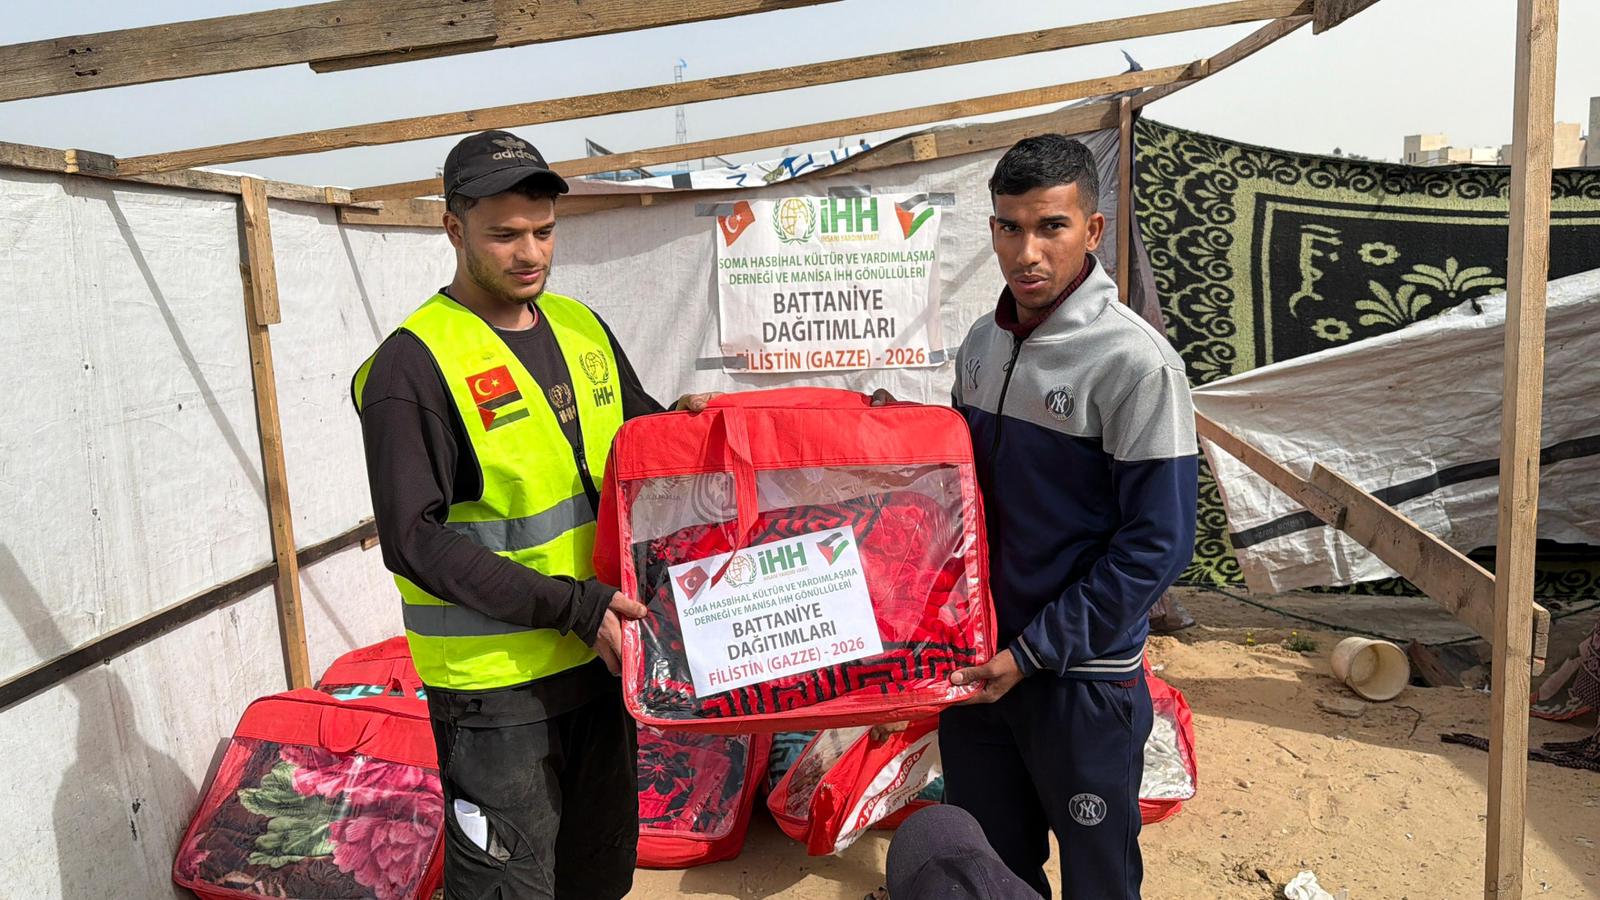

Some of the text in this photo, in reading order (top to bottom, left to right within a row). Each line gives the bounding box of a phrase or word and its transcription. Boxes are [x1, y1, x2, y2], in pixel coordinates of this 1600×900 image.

[492, 149, 538, 162] adidas
[719, 250, 936, 269] SOMA HASBİHAL KÜLTÜR VE YARDIMLAŞMA
[729, 264, 926, 285] DERNEĞİ VE MANİSA İHH GÖNÜLLÜLERİ
[773, 285, 883, 314] BATTANİYE
[762, 316, 895, 343] DAĞITIMLARI
[737, 349, 801, 370] İLİSTİN
[806, 349, 871, 369] (GAZZE)
[885, 348, 925, 365] 2026
[683, 567, 858, 617] SOMA HASBİHAL KÜLTÜR VE YARDIMLAŞMA
[694, 578, 852, 626] DERNEĞİ VE MANİSA İHH GÖNÜLLÜLERİ
[732, 602, 823, 639] BATTANİYE
[727, 620, 837, 661] DAĞITIMLARI
[708, 661, 764, 686] FİLİSTİN
[767, 646, 822, 674] (GAZZE)
[832, 637, 865, 657] 2026
